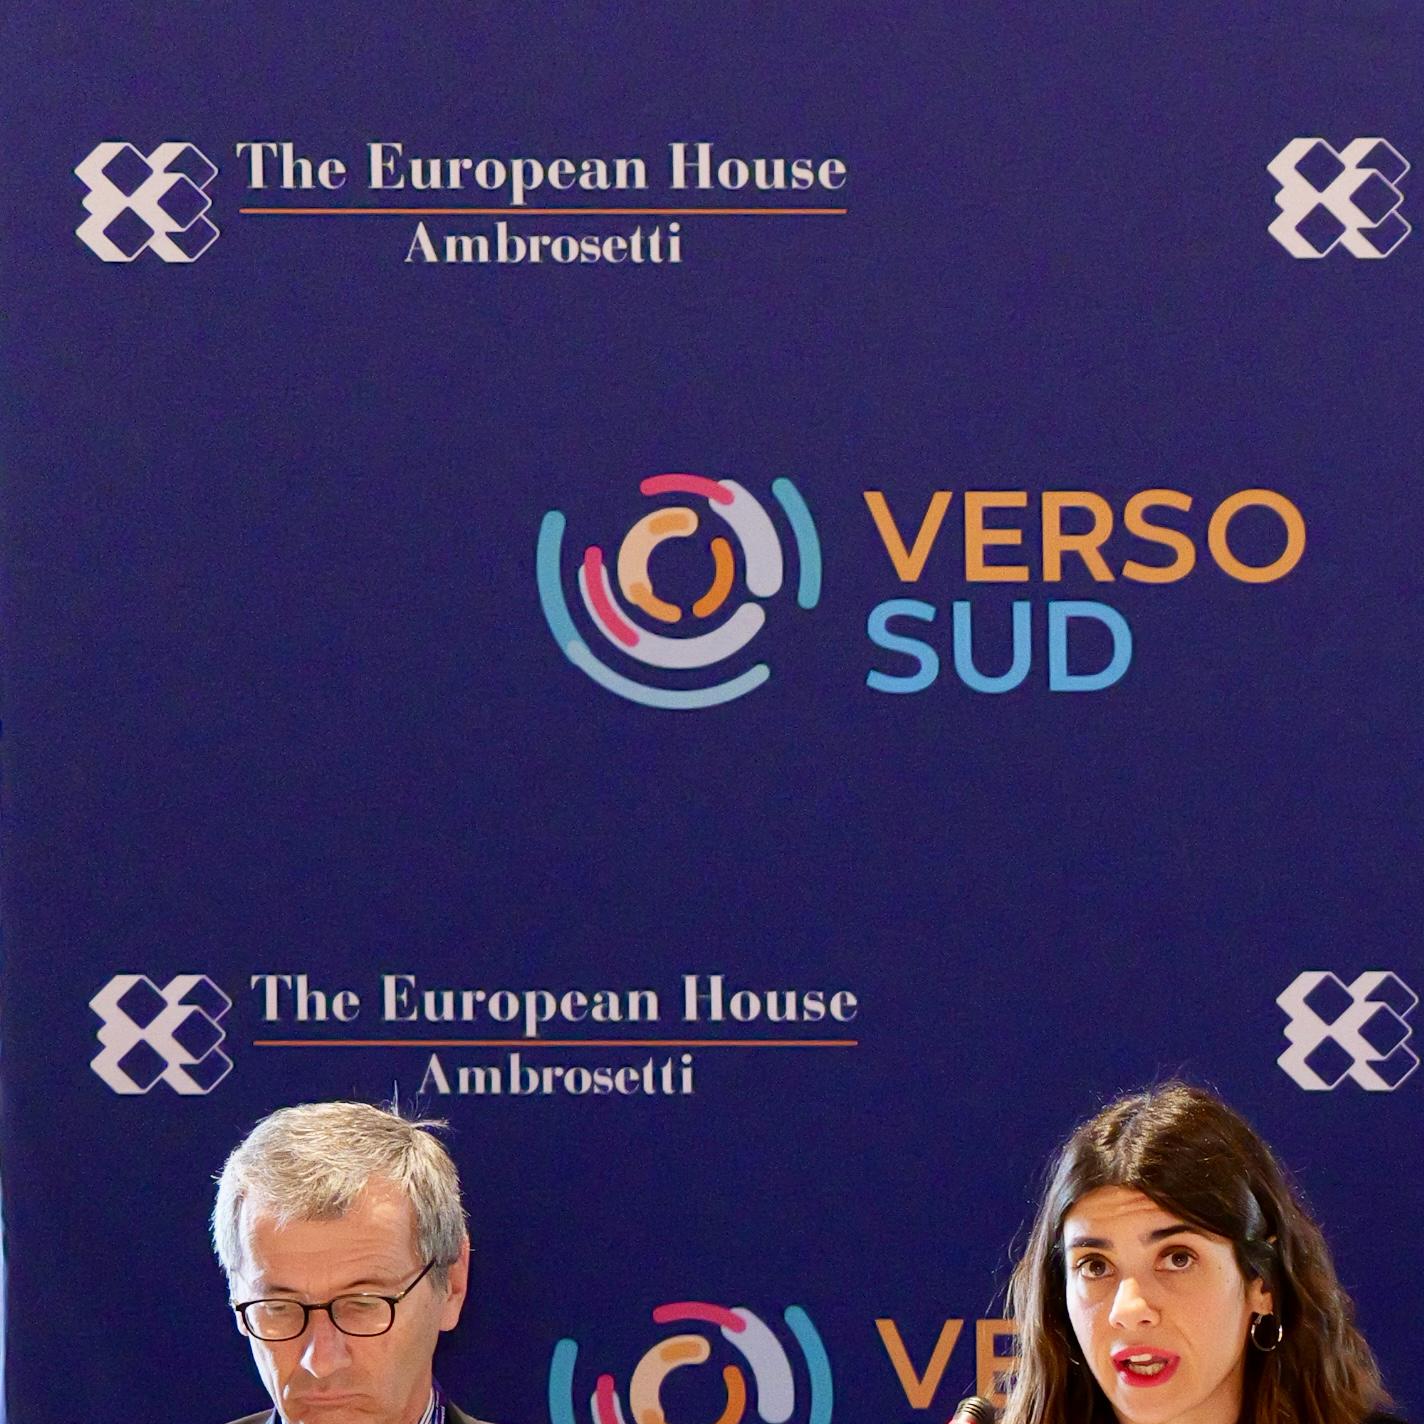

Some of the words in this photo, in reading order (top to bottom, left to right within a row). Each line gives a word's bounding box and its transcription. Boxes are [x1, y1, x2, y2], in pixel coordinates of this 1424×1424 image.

[237, 142, 346, 190] The
[367, 142, 647, 205] European
[669, 142, 847, 190] House
[404, 221, 682, 264] Ambrosetti
[863, 488, 1307, 584] VERSO
[866, 598, 1133, 694] SUD
[250, 974, 360, 1022] The
[383, 974, 658, 1037] European
[684, 974, 858, 1022] House
[418, 1053, 693, 1096] Ambrosetti
